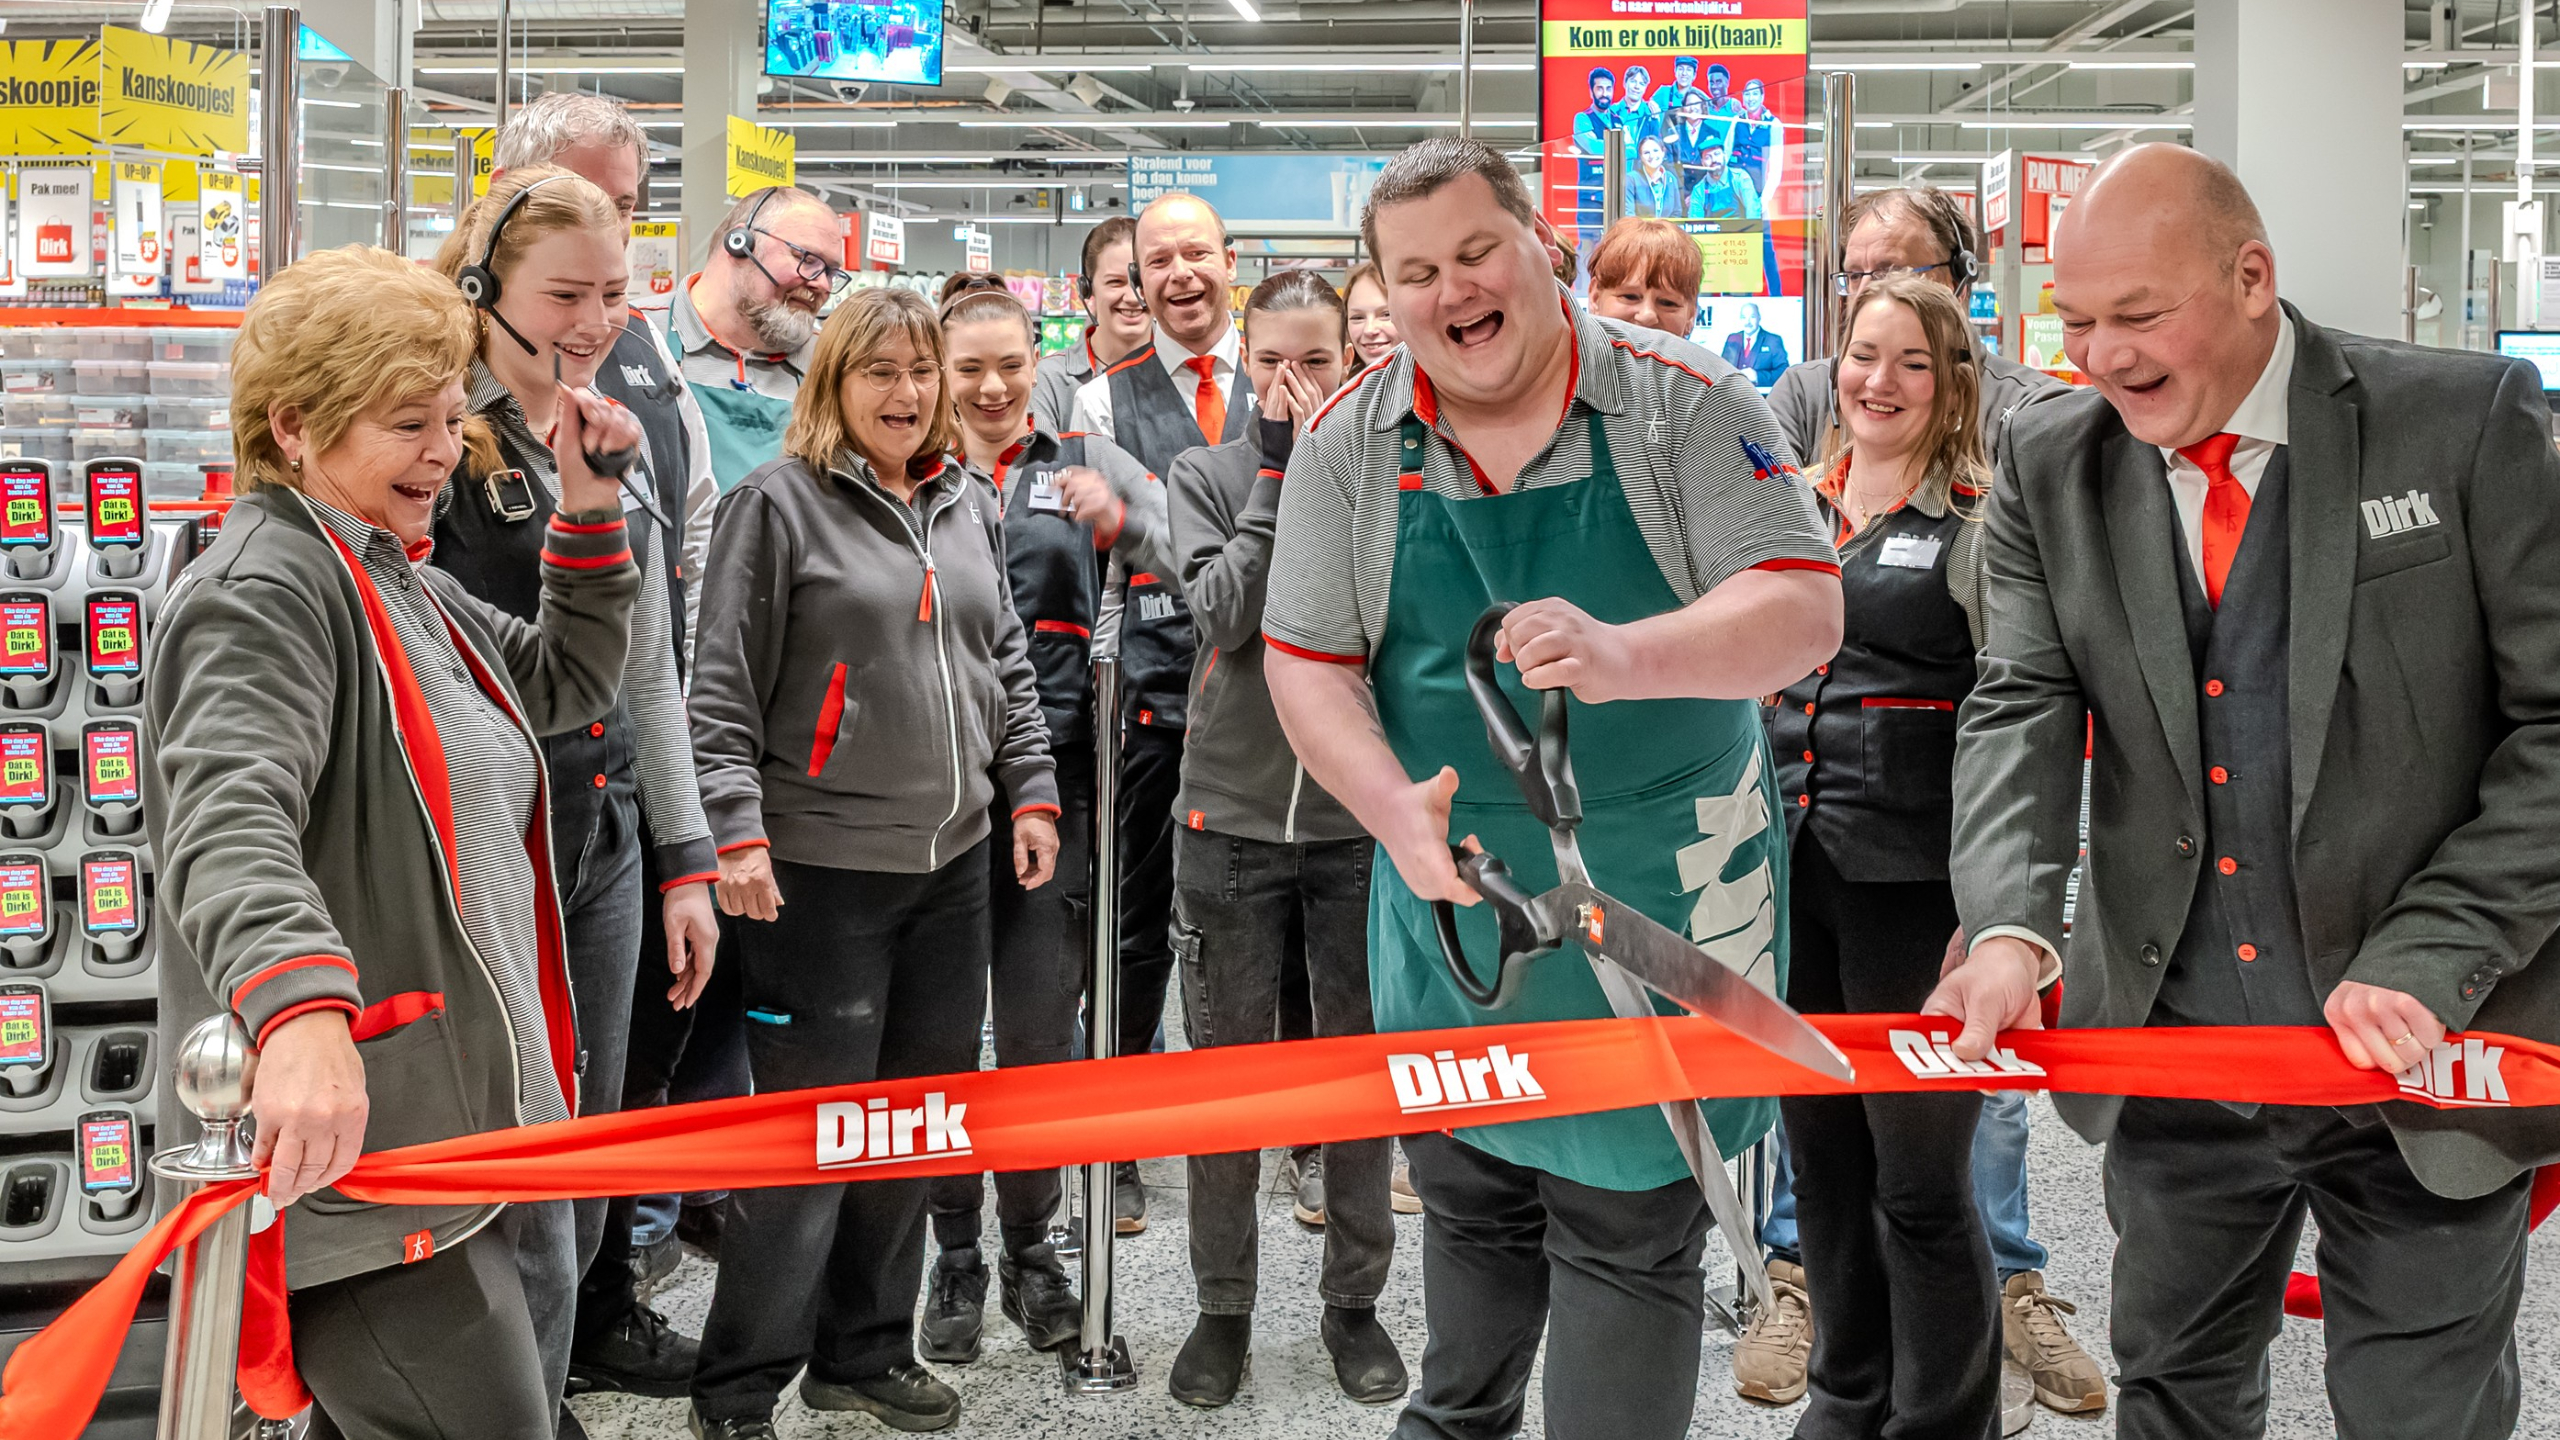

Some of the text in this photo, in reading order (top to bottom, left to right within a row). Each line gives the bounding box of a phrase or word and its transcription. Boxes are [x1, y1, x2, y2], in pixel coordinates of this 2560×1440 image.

[1569, 24, 1782, 49] Kom er ook bij(baan)!
[0, 76, 100, 107] skoopje
[122, 66, 235, 114] Kanskoopjes!
[736, 144, 787, 180] Kanskoopjes!
[1132, 156, 1212, 170] Stralend voor
[124, 163, 152, 181] OP=OP
[2027, 160, 2058, 191] PAK
[208, 173, 234, 190] OP=OP
[1132, 171, 1217, 186] de dag komen
[31, 183, 80, 195] Pak mee!
[635, 225, 666, 235] OP=OP
[39, 238, 68, 257] Dirk
[620, 364, 657, 387] Dirk
[28, 501, 35, 510] is
[120, 501, 127, 509] is
[12, 511, 36, 521] Dirk!
[104, 510, 128, 520] Dirk!
[2361, 490, 2440, 538] Dirk
[1139, 592, 1176, 621] Dirk
[27, 631, 35, 639] is
[119, 630, 126, 638] is
[11, 641, 35, 651] Dirk!
[103, 640, 126, 650] Dirk!
[25, 761, 32, 769] is
[116, 759, 124, 767] is
[9, 771, 32, 781] Dirk!
[101, 769, 124, 779] Dirk!
[22, 892, 30, 900] is
[114, 889, 122, 897] is
[6, 902, 30, 912] Dirk!
[99, 898, 122, 908] Dirk!
[22, 1022, 30, 1030] is
[6, 1031, 30, 1041] Dirk!
[1387, 1045, 1545, 1109] Dirk
[816, 1092, 972, 1166] Dirk
[112, 1147, 119, 1155] is
[96, 1157, 120, 1167] Dirk!
